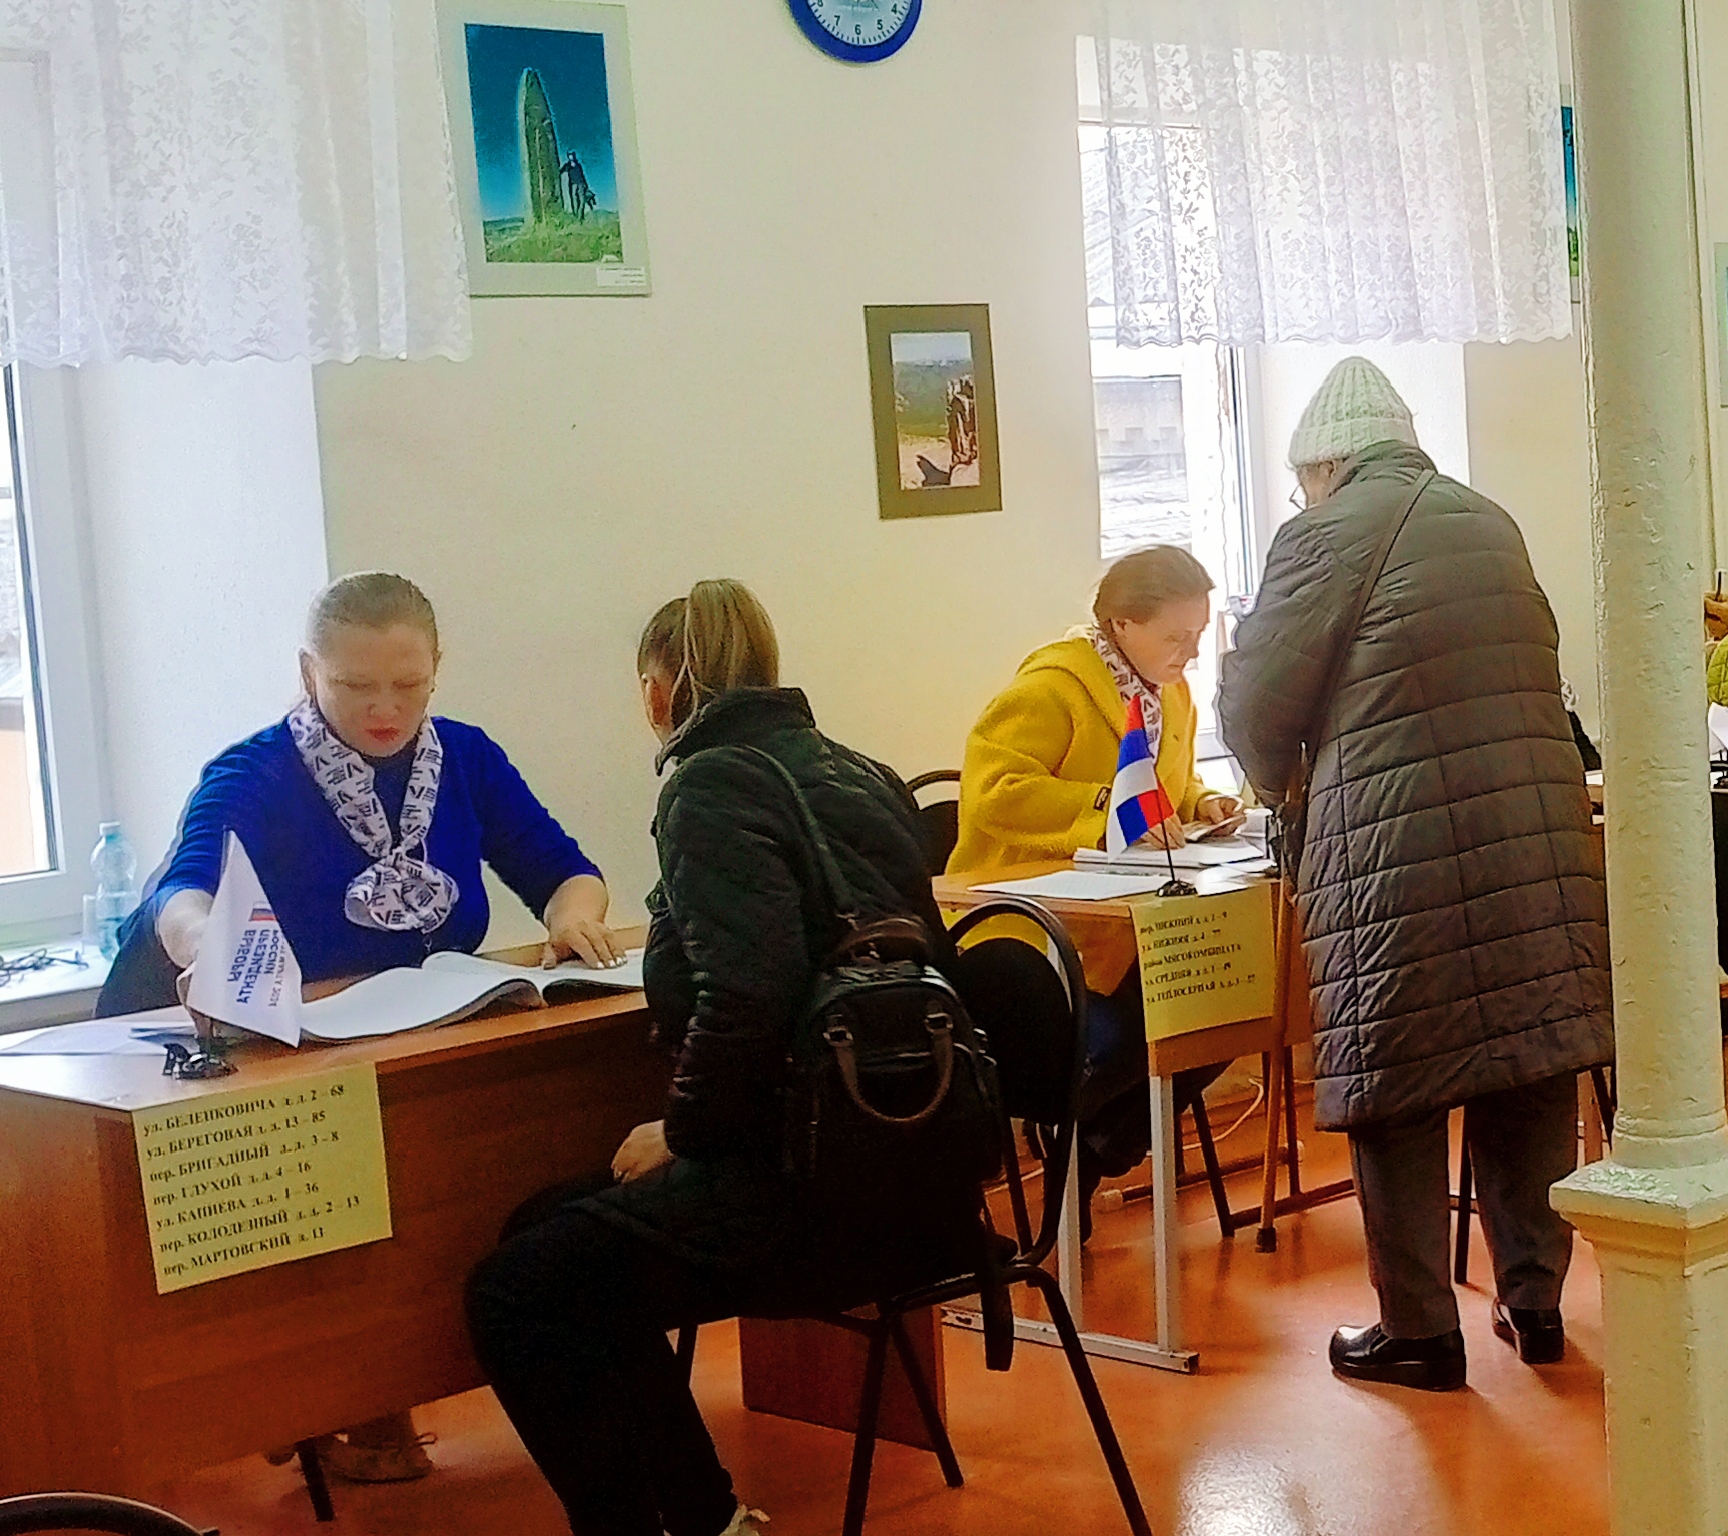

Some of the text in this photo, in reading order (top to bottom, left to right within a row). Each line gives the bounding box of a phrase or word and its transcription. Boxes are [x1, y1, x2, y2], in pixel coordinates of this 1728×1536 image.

[891, 3, 899, 14] 4
[834, 15, 840, 27] 7
[854, 24, 861, 35] 6
[877, 19, 884, 30] 5
[169, 1125, 253, 1154] БЕРЕГОВАЯ
[181, 1172, 242, 1199] ГЛУХОЙ
[187, 1209, 288, 1245] КОЛОДЕЗНЫЙ
[190, 1232, 291, 1268] МАРТОВСКИЙ
